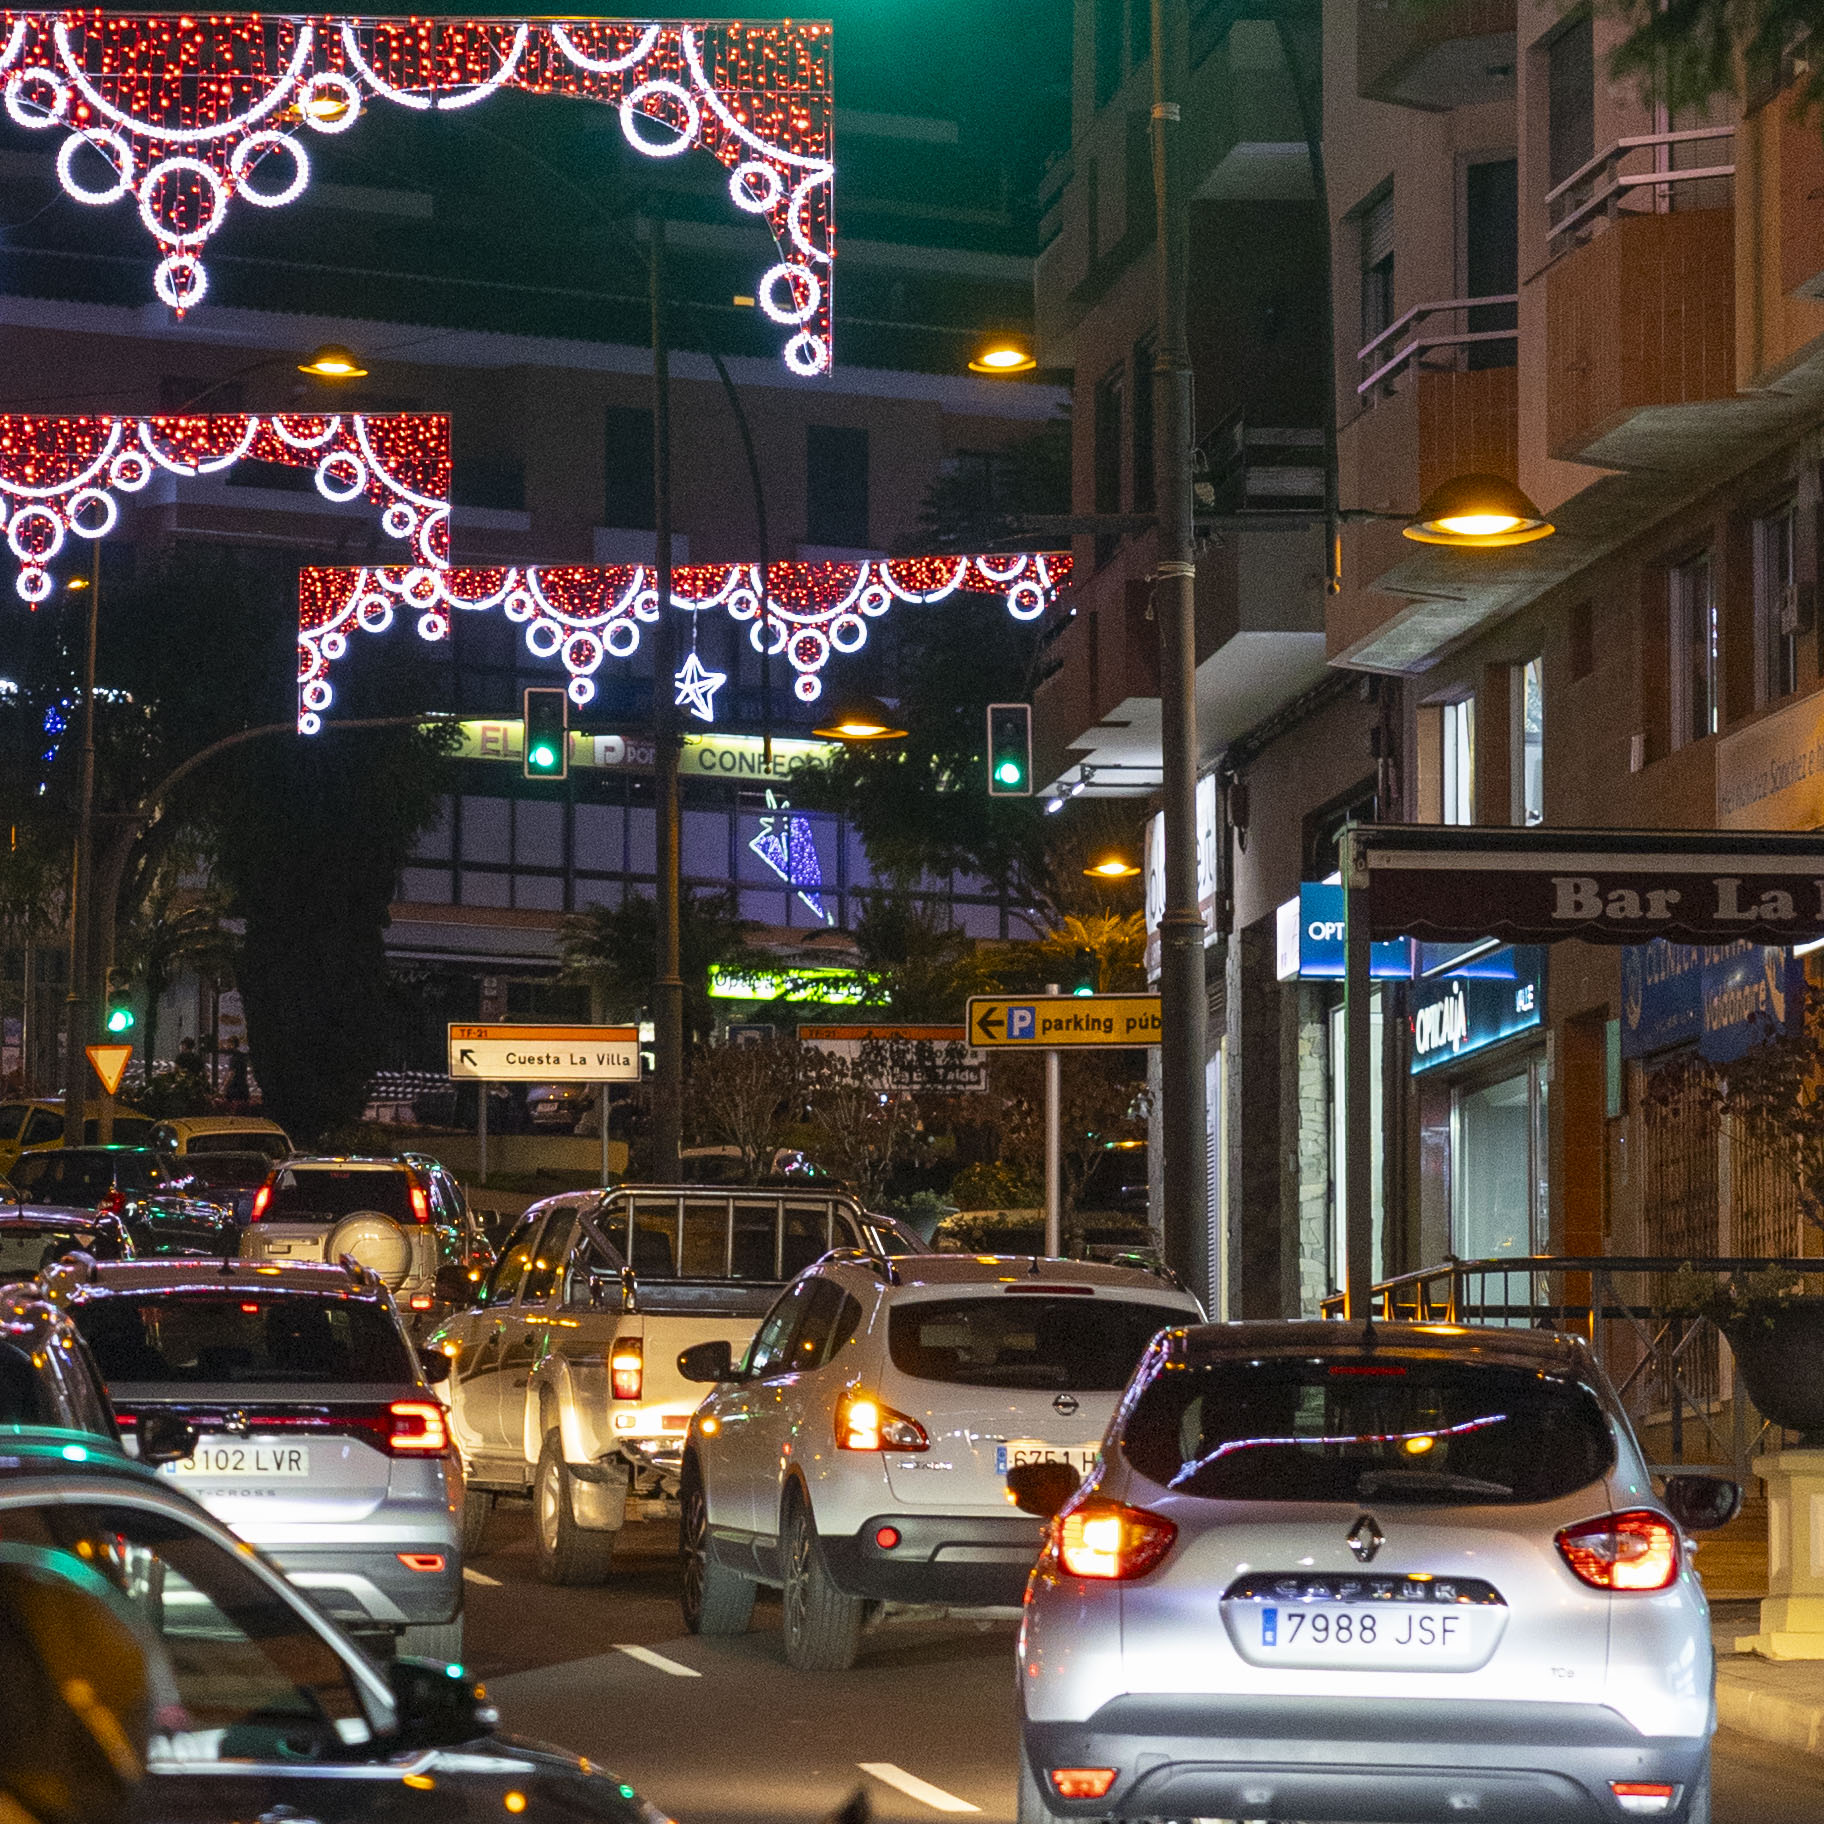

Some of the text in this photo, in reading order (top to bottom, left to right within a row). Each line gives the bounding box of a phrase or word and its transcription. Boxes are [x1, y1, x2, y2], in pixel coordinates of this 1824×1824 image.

[481, 726, 521, 755] EL
[1552, 877, 1798, 920] Bar La
[1042, 1014, 1113, 1034] parking
[506, 1052, 631, 1066] Cuesta La Villa
[255, 1449, 302, 1472] LVR
[1287, 1613, 1461, 1646] 7988 JSF
